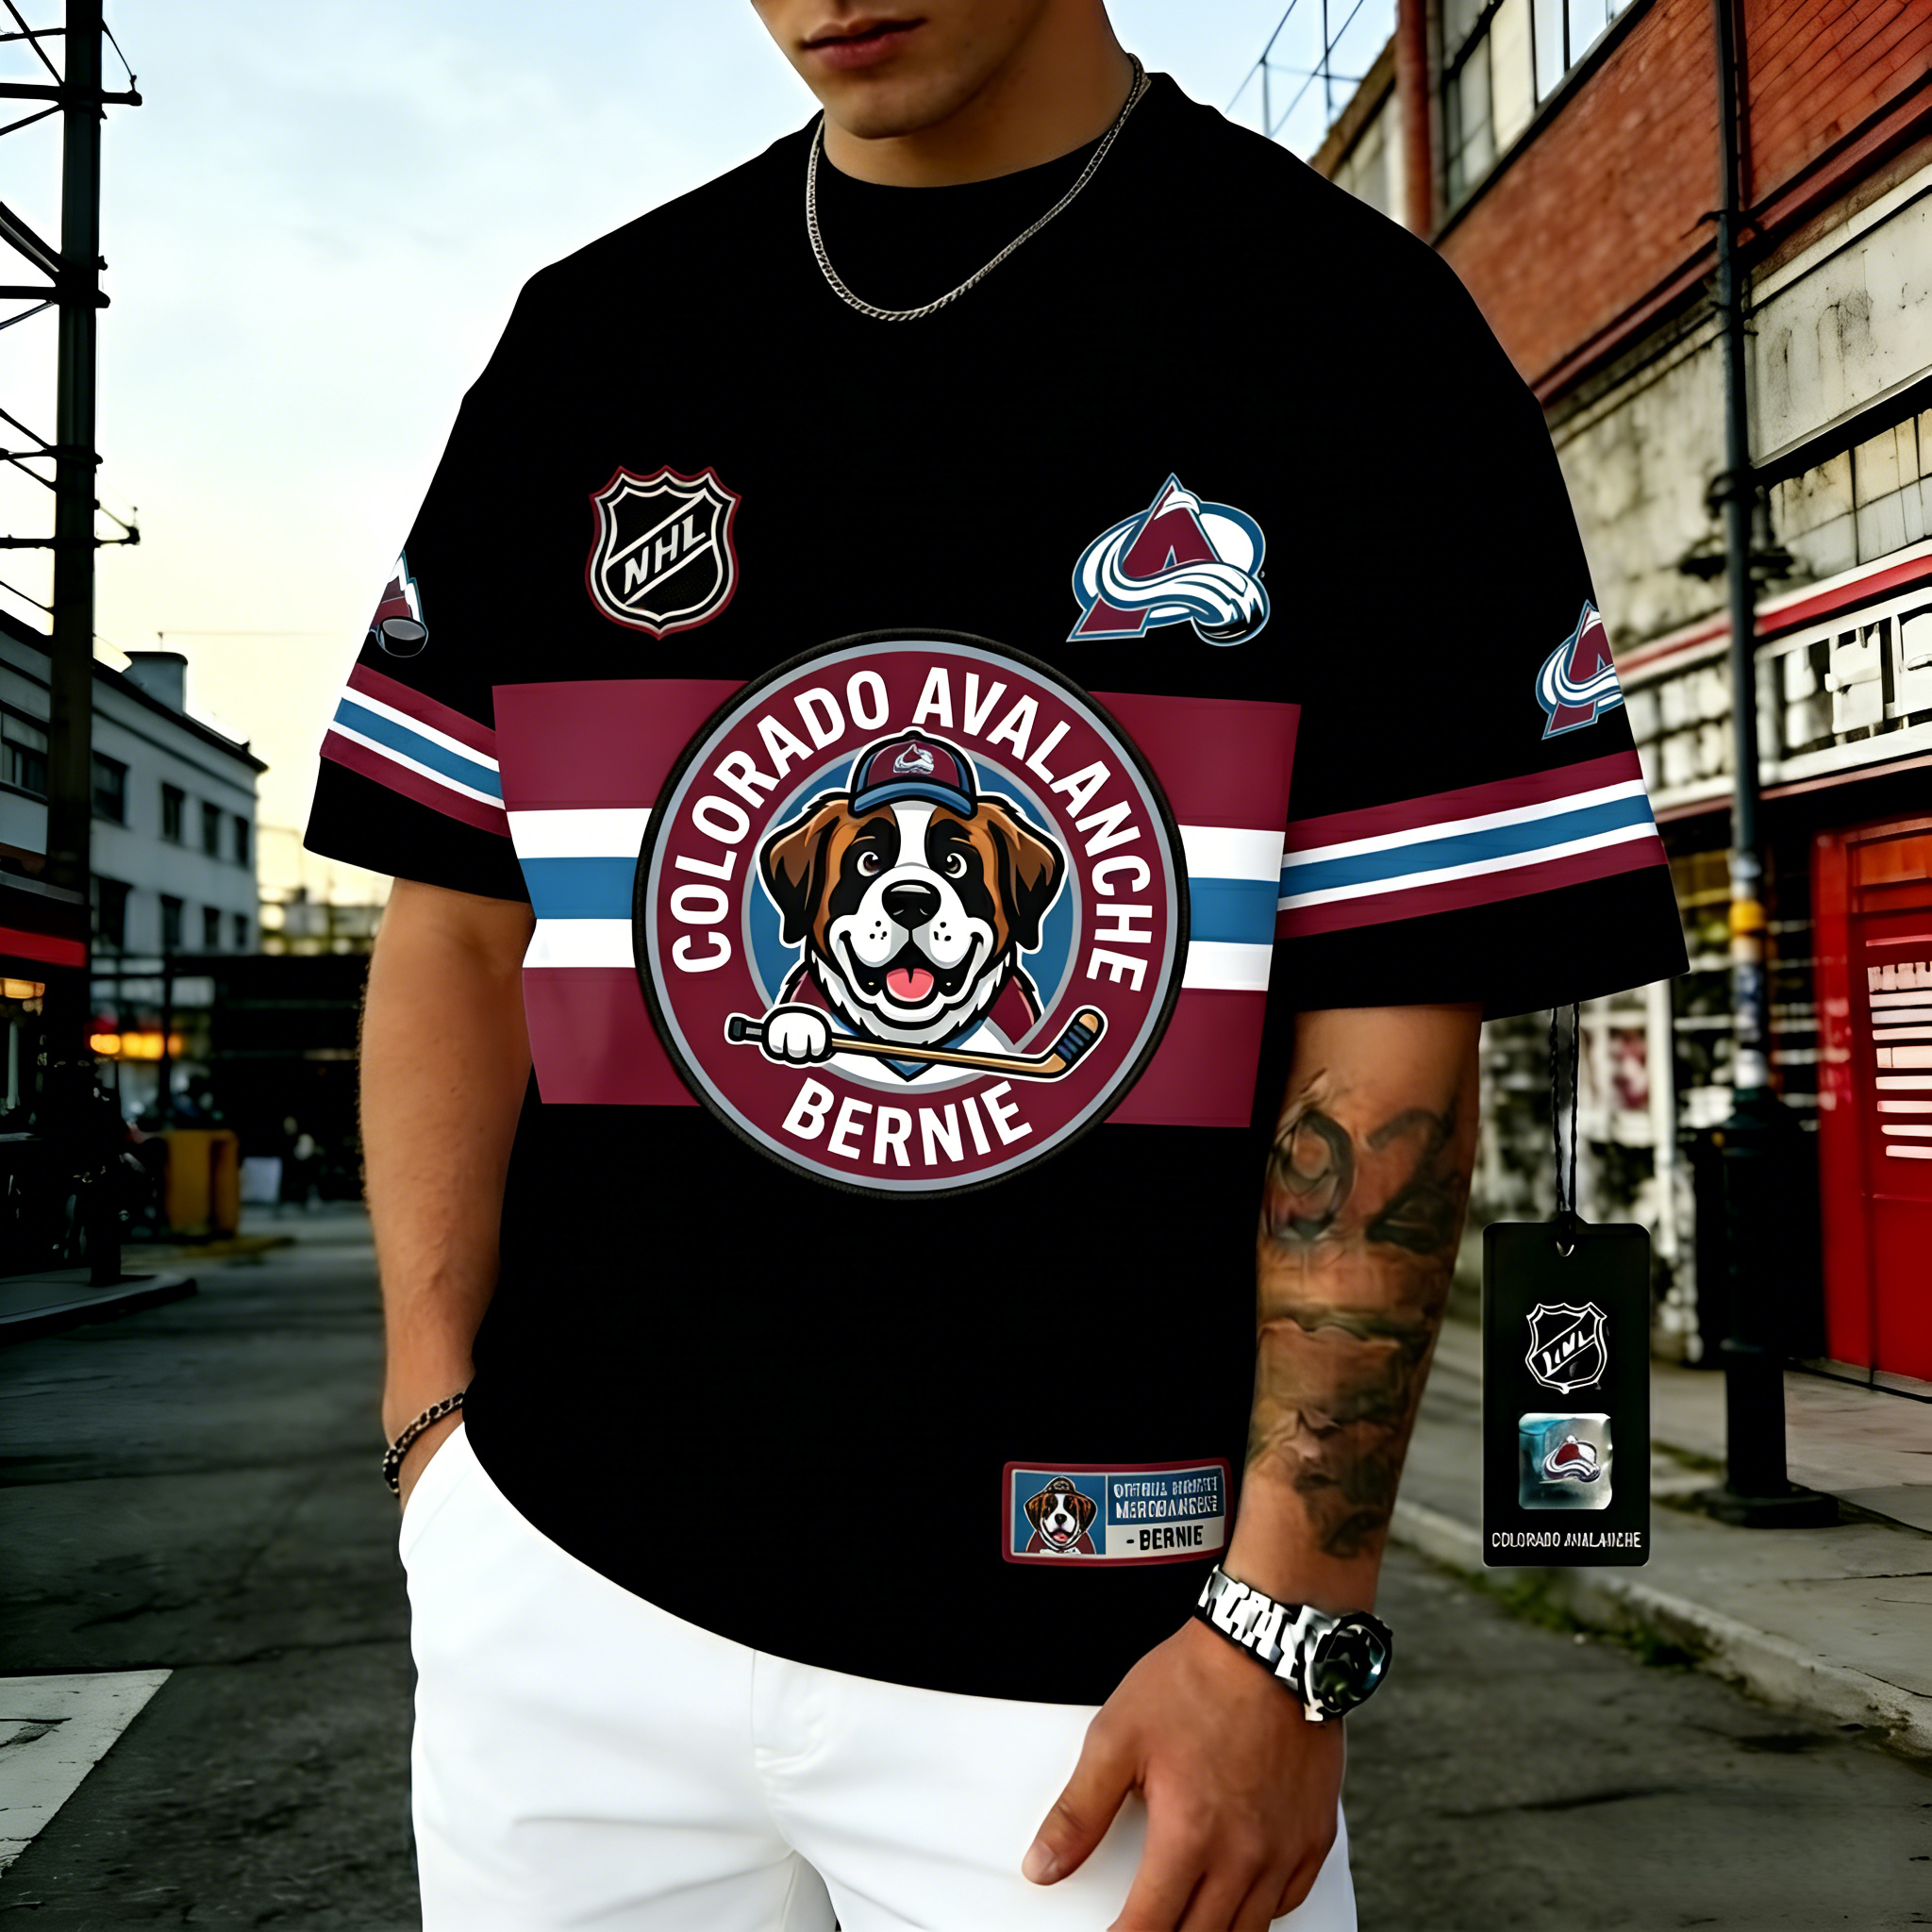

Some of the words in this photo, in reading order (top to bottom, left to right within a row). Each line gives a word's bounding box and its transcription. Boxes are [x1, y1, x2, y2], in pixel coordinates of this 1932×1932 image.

[624, 514, 707, 594] NHL
[670, 670, 891, 973] COLORADO
[911, 667, 1153, 991] AVALANCHE
[781, 1077, 1033, 1167] BERNIE
[1139, 1524, 1204, 1551] BERNIE
